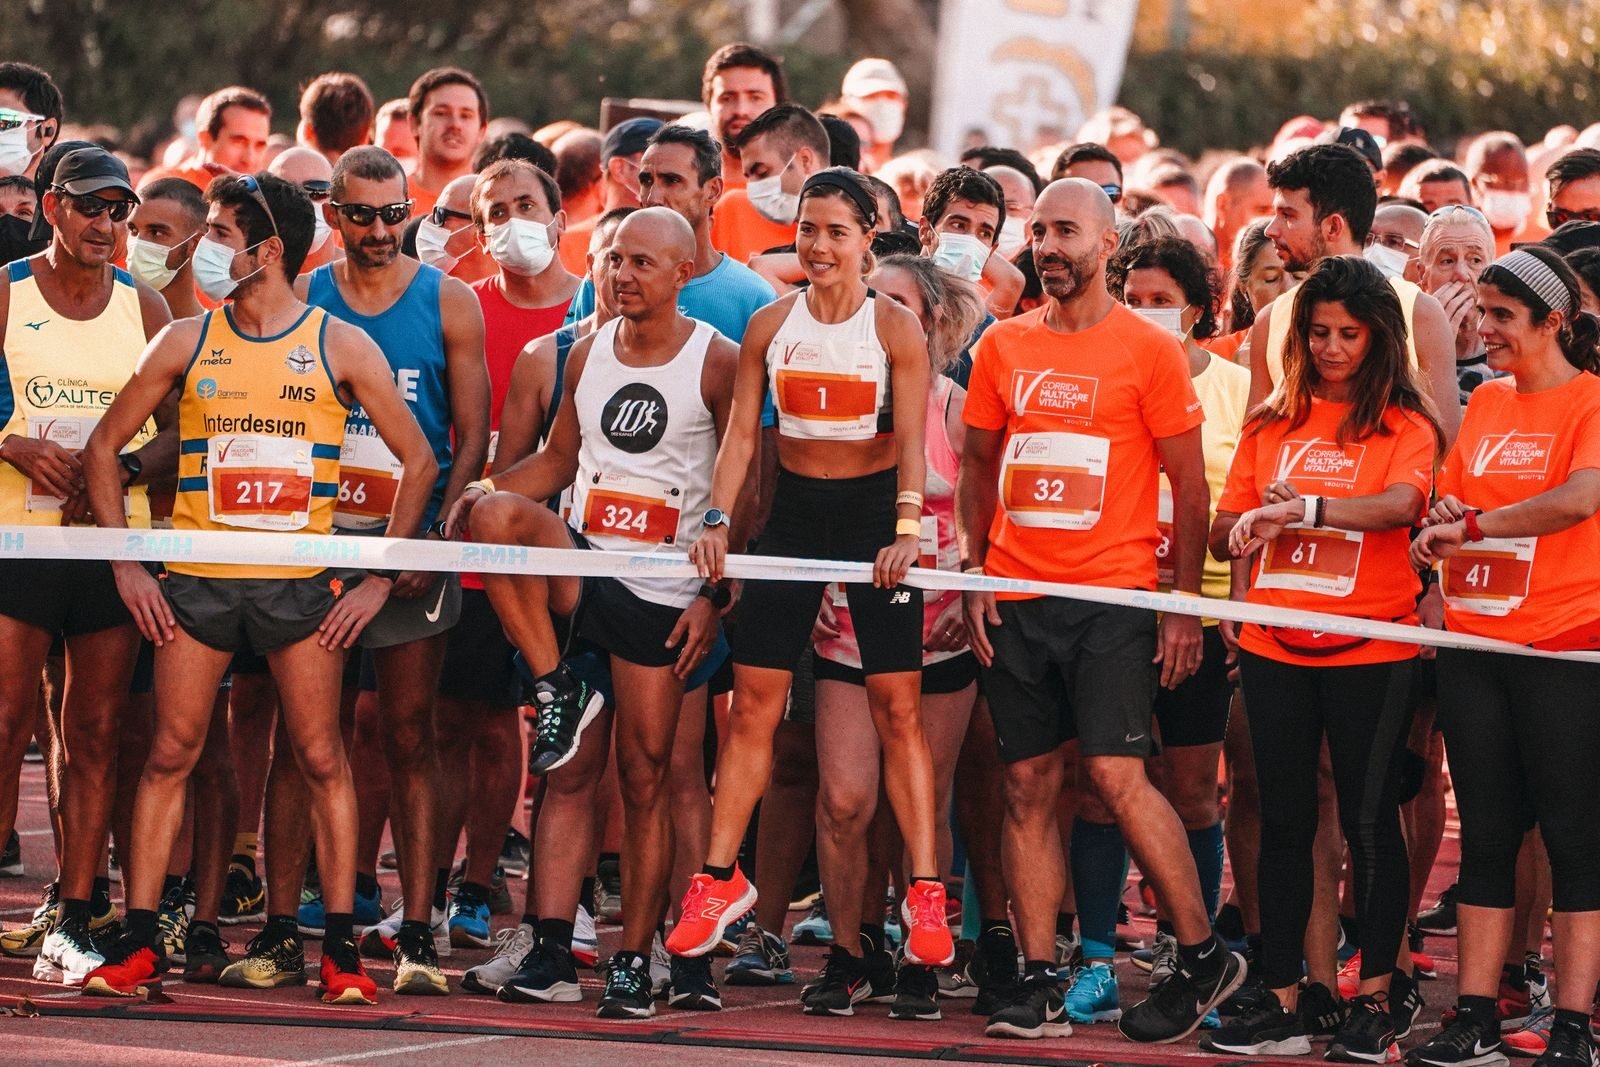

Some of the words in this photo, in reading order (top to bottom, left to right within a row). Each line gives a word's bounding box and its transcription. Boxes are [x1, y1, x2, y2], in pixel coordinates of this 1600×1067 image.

[200, 357, 232, 365] meta
[57, 378, 88, 387] CLÍNICA
[1042, 381, 1079, 391] CORRIDA
[55, 389, 117, 405] AUTE
[279, 385, 316, 402] JMS
[817, 387, 826, 410] 1
[1040, 389, 1088, 402] MULTICARE
[1038, 398, 1078, 409] VITALITY
[203, 413, 306, 438] Interdesign
[1505, 442, 1537, 450] CORRIDA
[1308, 449, 1345, 459] CORRIDA
[1501, 450, 1545, 458] MULTICARE
[1305, 457, 1355, 467] MULTICARE
[1499, 457, 1534, 465] VITALITY
[1304, 464, 1343, 473] VITALITY
[236, 481, 283, 504] 217
[1033, 478, 1065, 502] 32
[602, 504, 648, 533] 324
[1291, 542, 1318, 565] 61
[1465, 564, 1491, 587] 41
